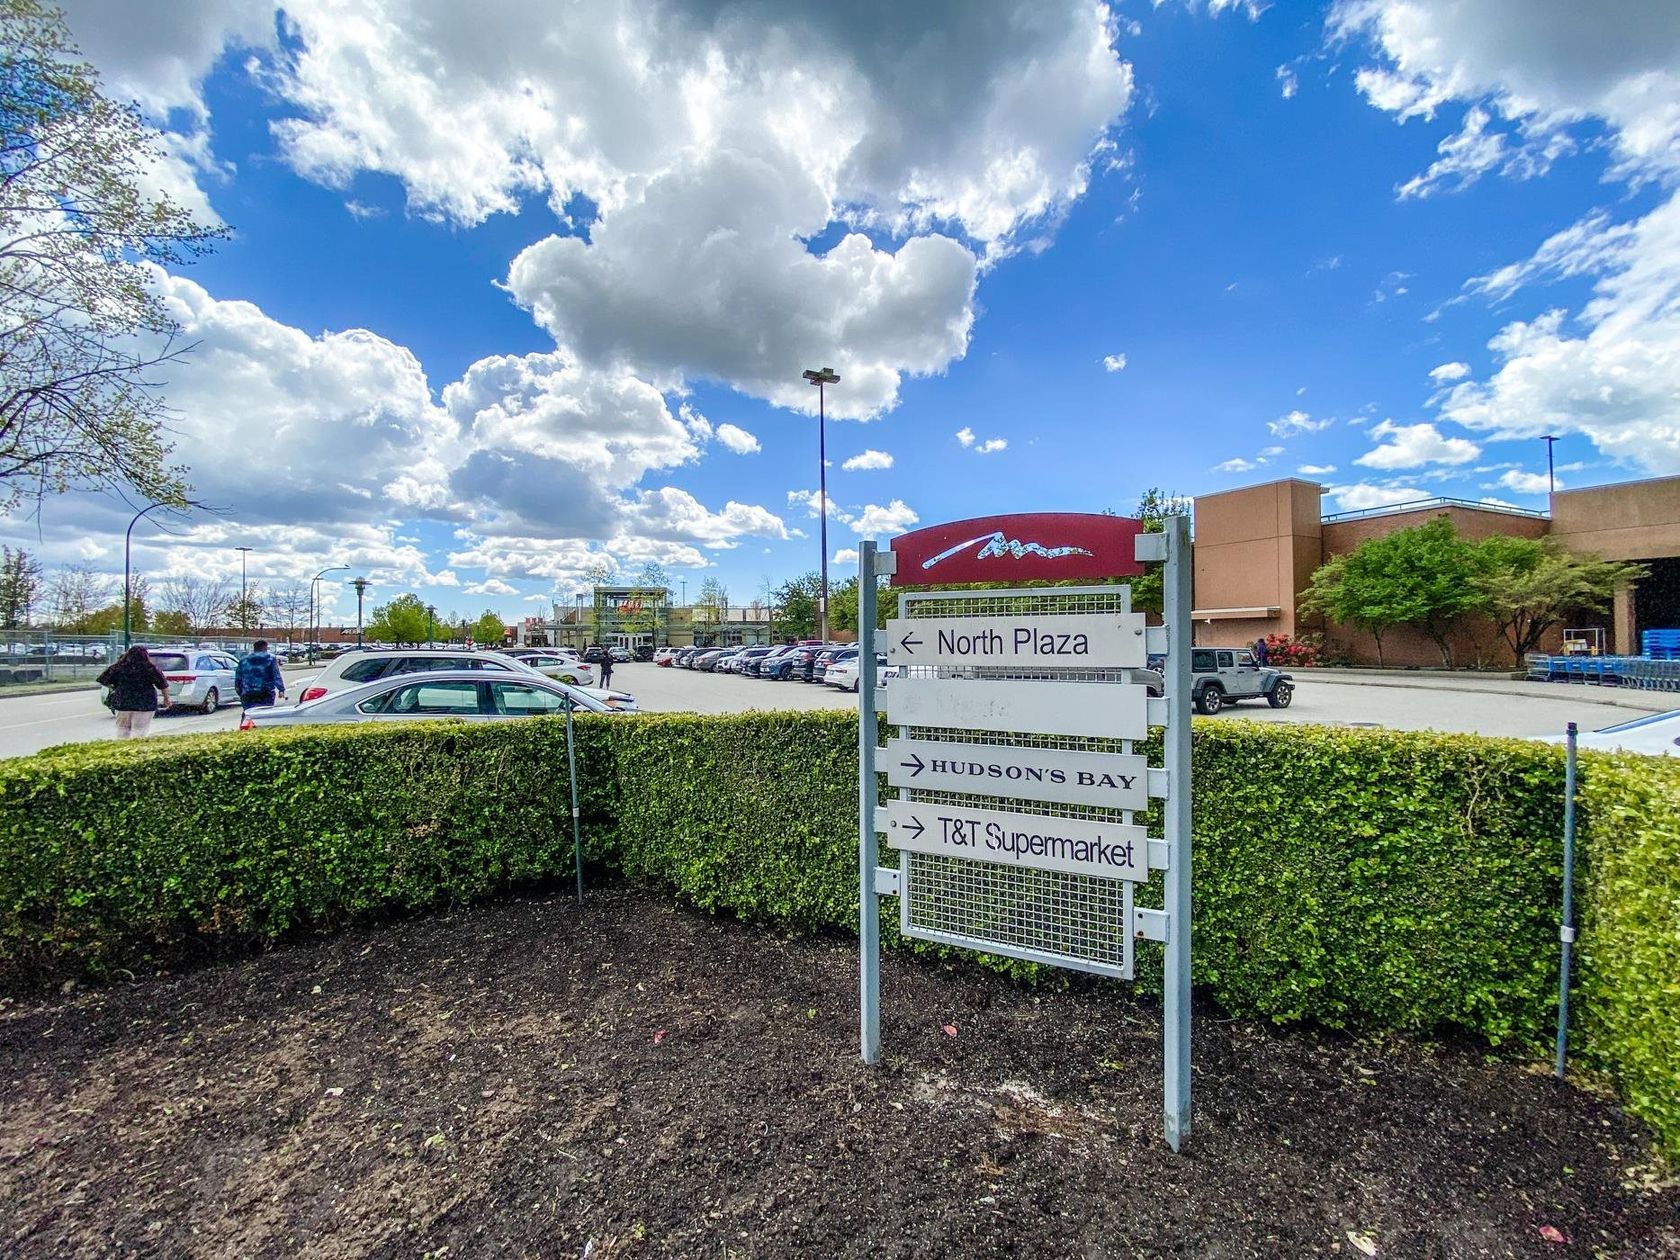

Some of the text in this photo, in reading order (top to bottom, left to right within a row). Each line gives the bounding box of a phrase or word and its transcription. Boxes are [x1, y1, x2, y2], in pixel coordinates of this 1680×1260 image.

[937, 627, 1089, 656] North Plaza
[930, 759, 1137, 790] HUDSON'S BAY
[937, 816, 1135, 868] T&T Supermarket
